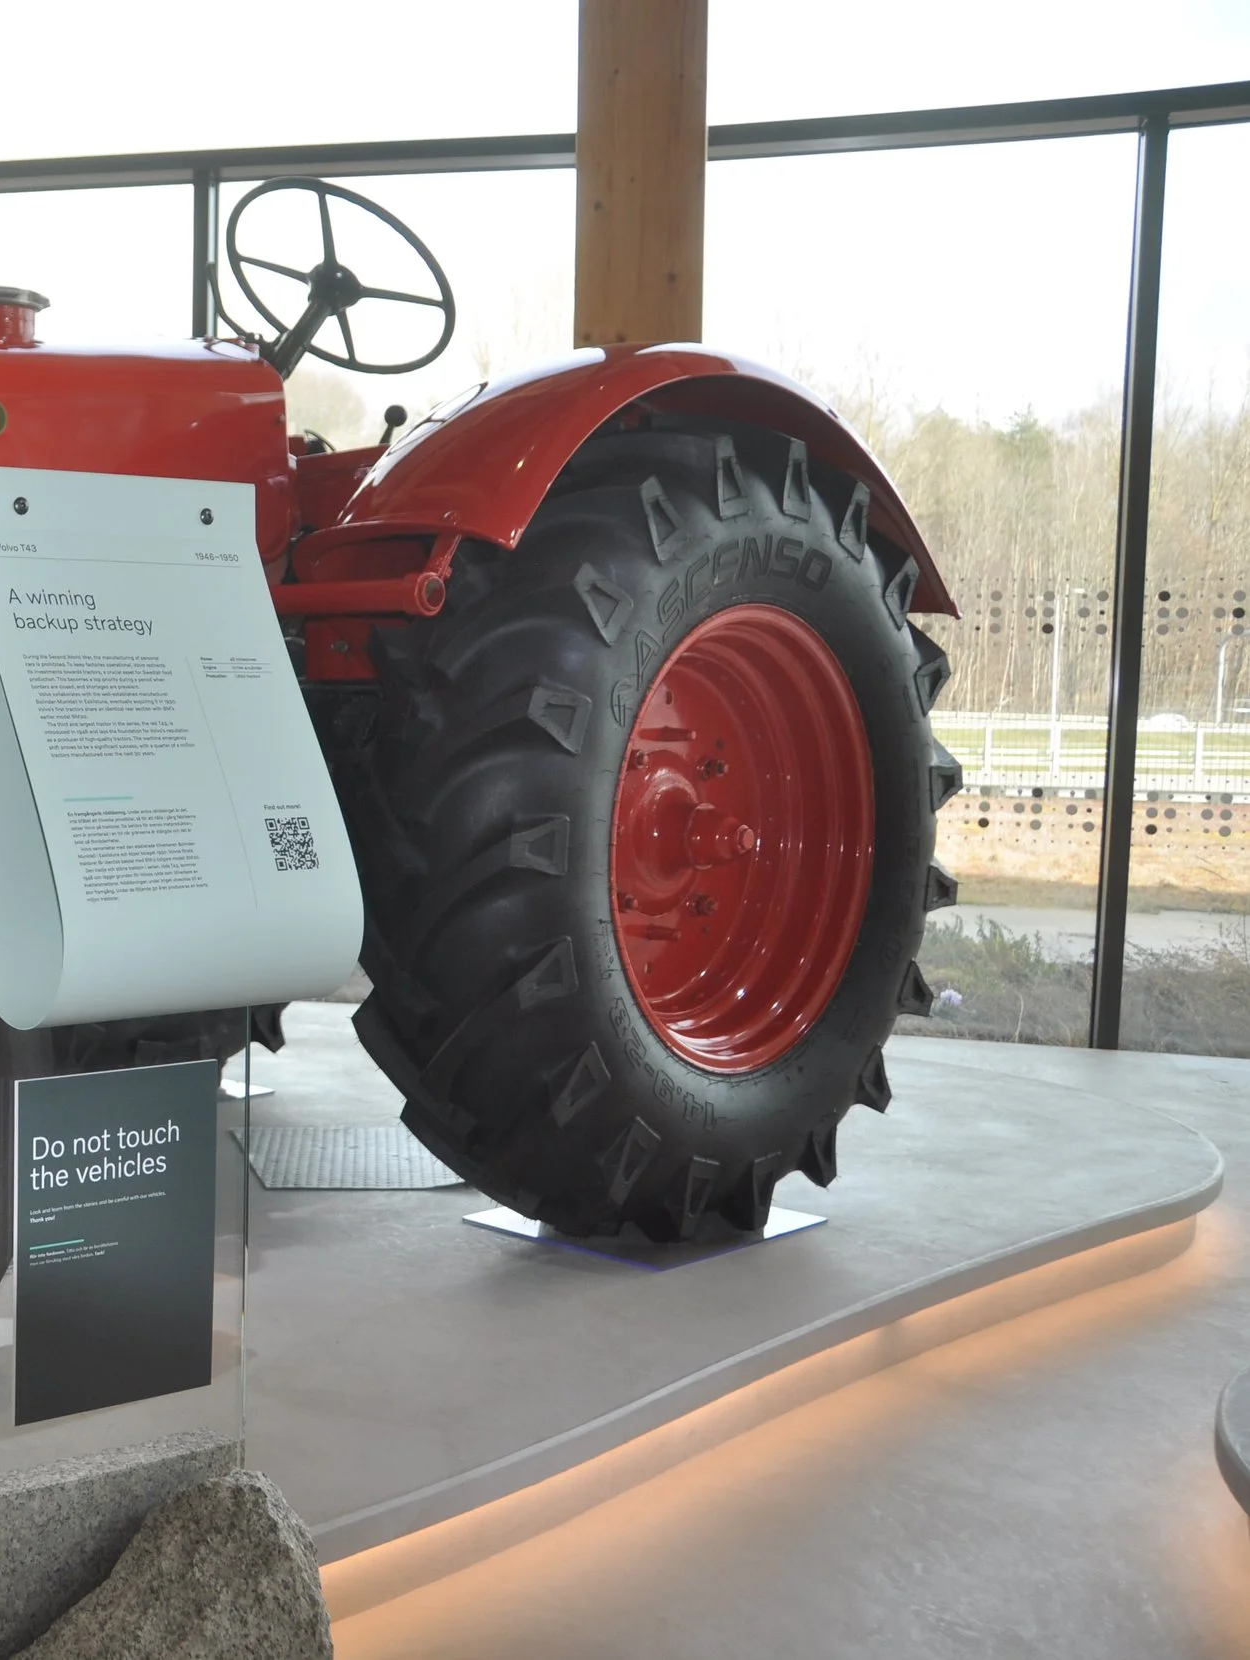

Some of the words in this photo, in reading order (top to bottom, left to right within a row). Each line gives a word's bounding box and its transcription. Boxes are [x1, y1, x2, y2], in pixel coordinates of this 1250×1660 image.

[20, 544, 37, 552] T43
[8, 588, 22, 604] A
[26, 588, 96, 611] winning
[636, 534, 833, 692] ASCENSO
[13, 612, 79, 634] backup
[84, 615, 153, 636] strategy
[32, 1135, 65, 1161] Do
[73, 1129, 110, 1156] not
[117, 1120, 180, 1150] touch
[30, 1165, 69, 1191] the
[76, 1152, 166, 1184] vehicles
